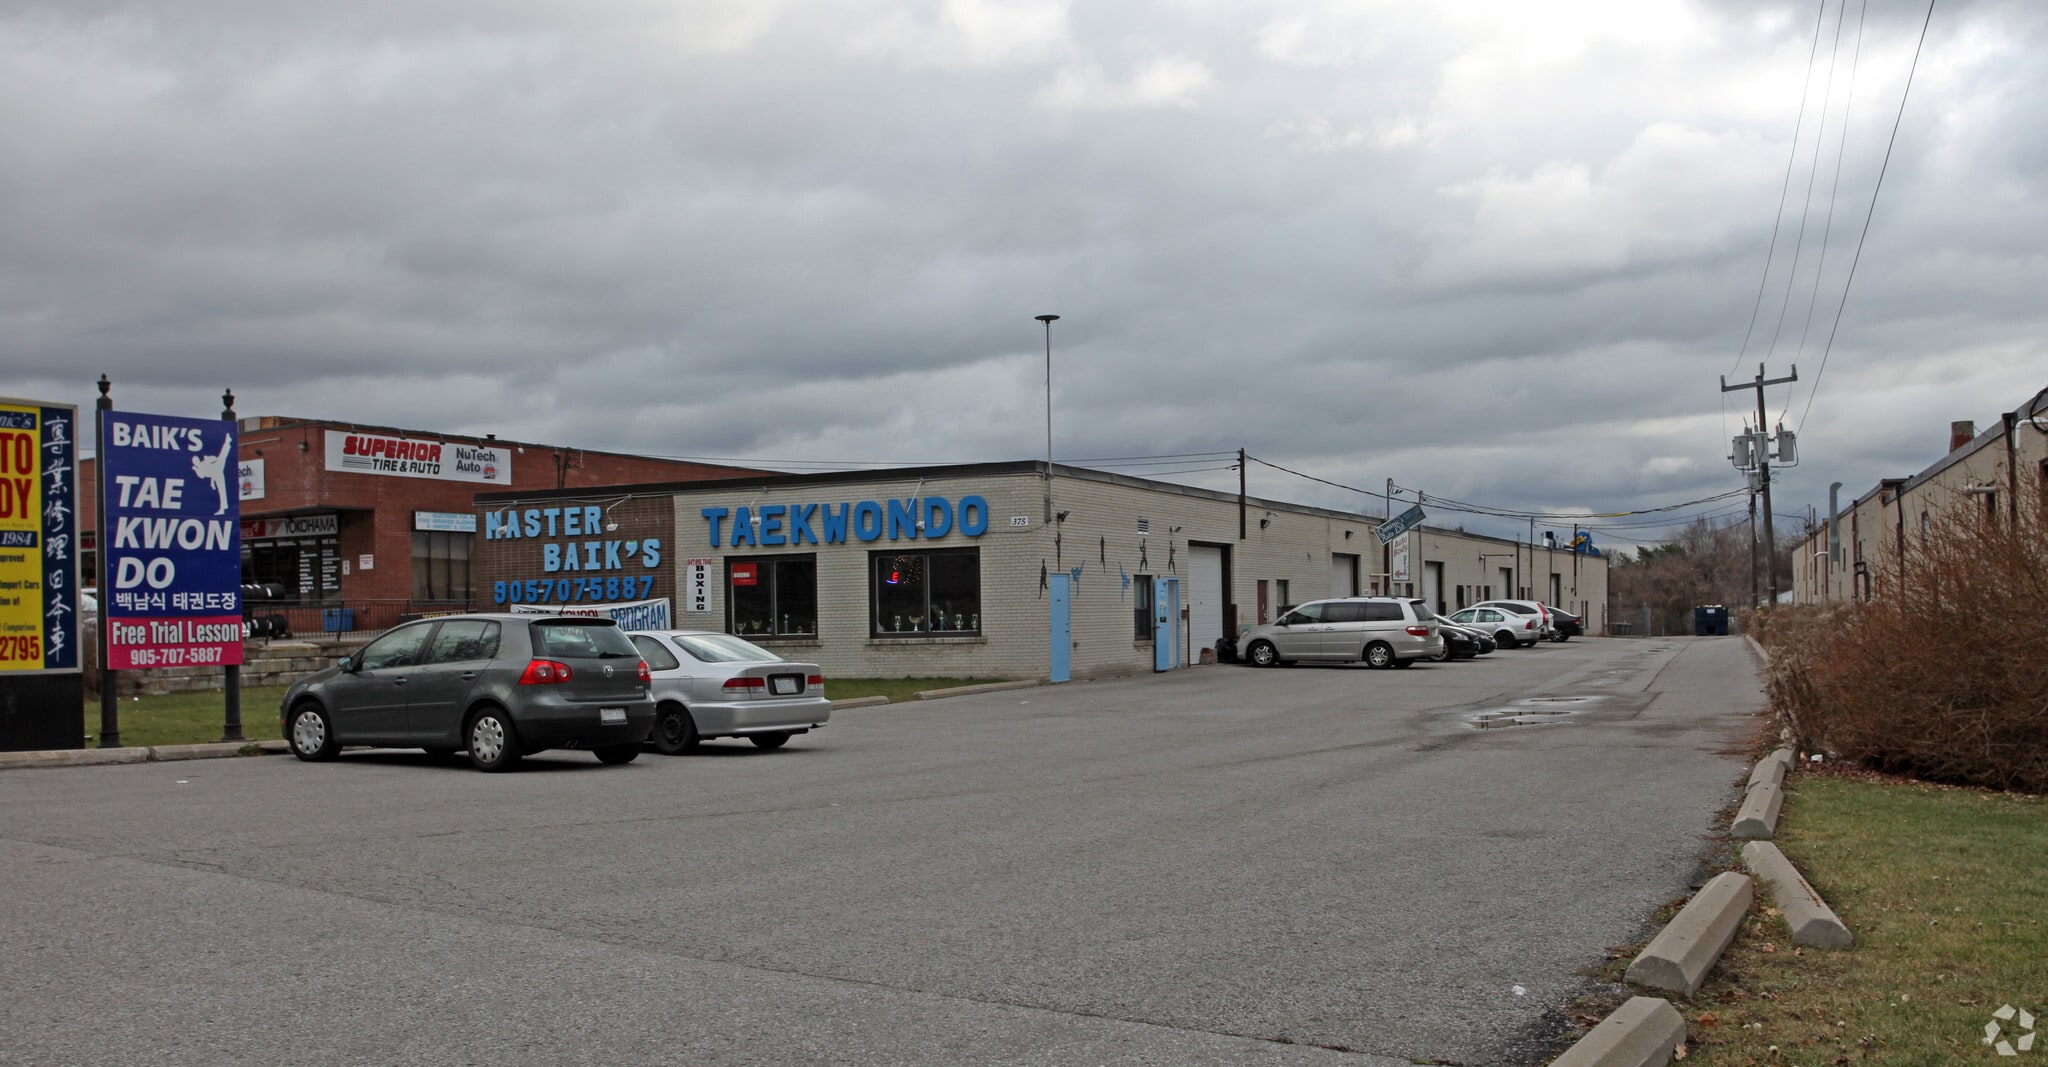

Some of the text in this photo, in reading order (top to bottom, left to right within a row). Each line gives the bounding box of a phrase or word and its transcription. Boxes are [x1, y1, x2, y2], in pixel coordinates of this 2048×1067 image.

[113, 422, 203, 451] BAIK'S
[343, 436, 442, 462] SUPERIOR
[372, 459, 441, 475] TIRE & AUTO
[456, 447, 496, 462] NuTech
[456, 460, 481, 473] Auto
[115, 475, 184, 509] TAE
[114, 516, 232, 551] KWON
[285, 518, 337, 534] YOKOHAMA
[486, 506, 602, 540] MASTER
[701, 495, 989, 547] TAEKWONDO
[1011, 517, 1026, 526] 375
[1, 532, 32, 546] 1984
[543, 539, 661, 572] BAIK'S
[115, 557, 175, 589] DO
[494, 576, 654, 604] 905-707-5887
[696, 565, 705, 611] BOXING
[116, 592, 237, 611] 백남식 태권도장
[610, 604, 666, 632] PROGRAM
[112, 620, 240, 645] Free Trial Lesson
[0, 636, 40, 660] 2795
[130, 647, 223, 665] 905-707-5887
